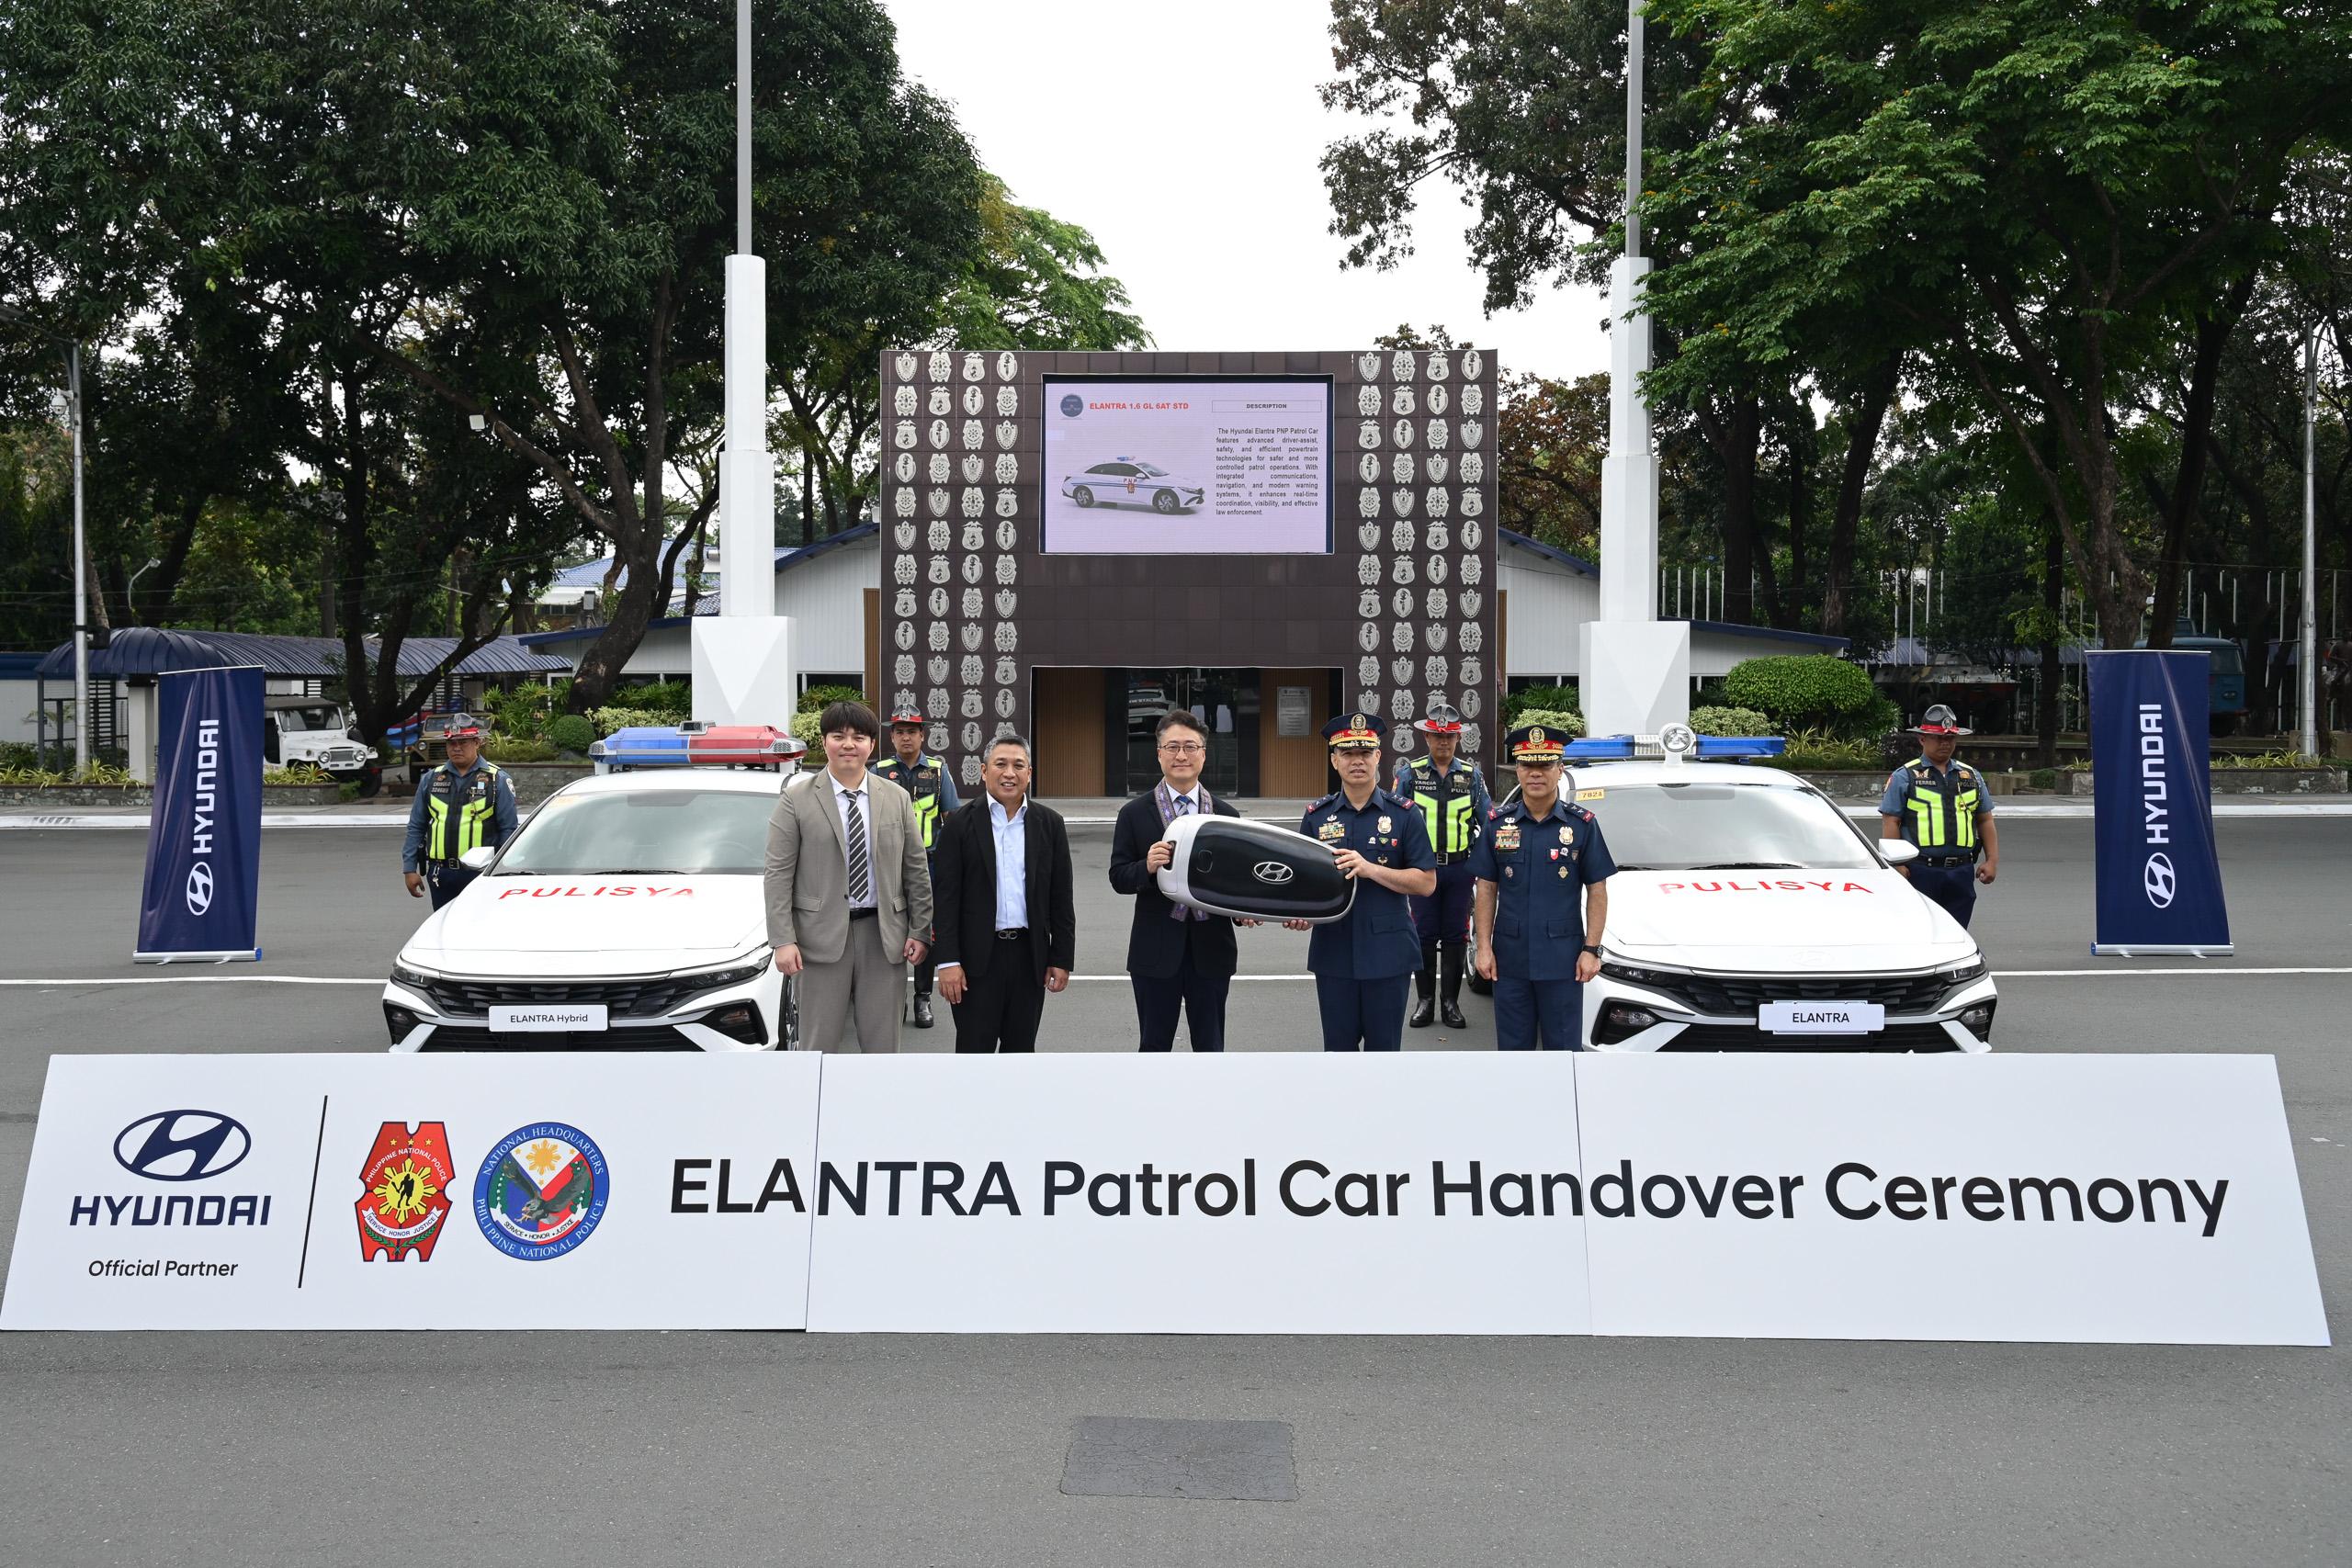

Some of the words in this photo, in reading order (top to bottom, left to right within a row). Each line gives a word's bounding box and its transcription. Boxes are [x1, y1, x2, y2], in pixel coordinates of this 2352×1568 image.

[192, 719, 219, 854] HYUNDAI
[2139, 704, 2169, 844] HYUNDAI
[498, 887, 694, 900] PULISYA
[1658, 881, 1874, 894] PULISYA
[510, 1015, 555, 1023] ELANTRA
[557, 1014, 588, 1023] Hybrid
[1792, 1012, 1850, 1023] ELANTRA
[483, 1132, 530, 1175] NATIONAL
[532, 1127, 603, 1175] HEADQUARTERS
[366, 1151, 397, 1183] PHILIPPINE
[398, 1148, 431, 1160] NATIONAL
[431, 1157, 447, 1182] POLICE
[670, 1158, 1022, 1216] ELANTRA
[1044, 1158, 1256, 1216] Patrol
[1279, 1159, 1410, 1217] Car
[1433, 1160, 1804, 1219] Handover
[1825, 1162, 2230, 1237] Ceremony
[69, 1195, 272, 1226] HYUNDAI
[368, 1215, 387, 1234] SERVICE
[413, 1217, 435, 1234] JUSTICE
[476, 1198, 516, 1253] PHILIPPINE
[518, 1239, 574, 1257] NATIONAL
[576, 1199, 604, 1239] POLICE
[503, 1221, 524, 1237] SERVICE
[88, 1259, 159, 1277] Official
[164, 1260, 238, 1277] Partner
